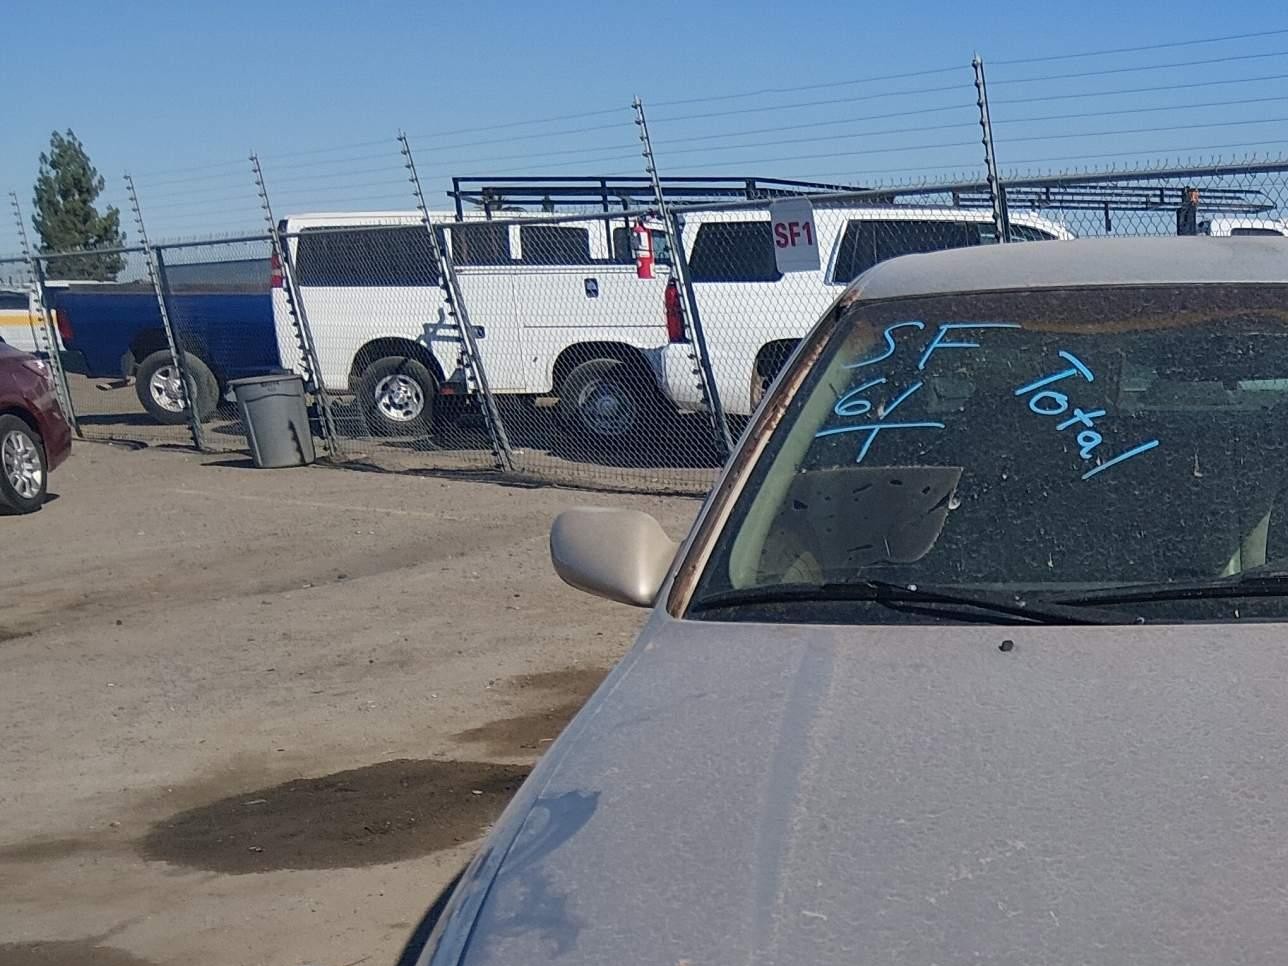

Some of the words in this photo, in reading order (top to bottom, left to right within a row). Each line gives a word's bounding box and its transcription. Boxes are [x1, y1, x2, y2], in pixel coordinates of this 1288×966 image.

[774, 221, 813, 249] SF1
[841, 322, 1021, 370] SF
[1014, 350, 1160, 481] Total
